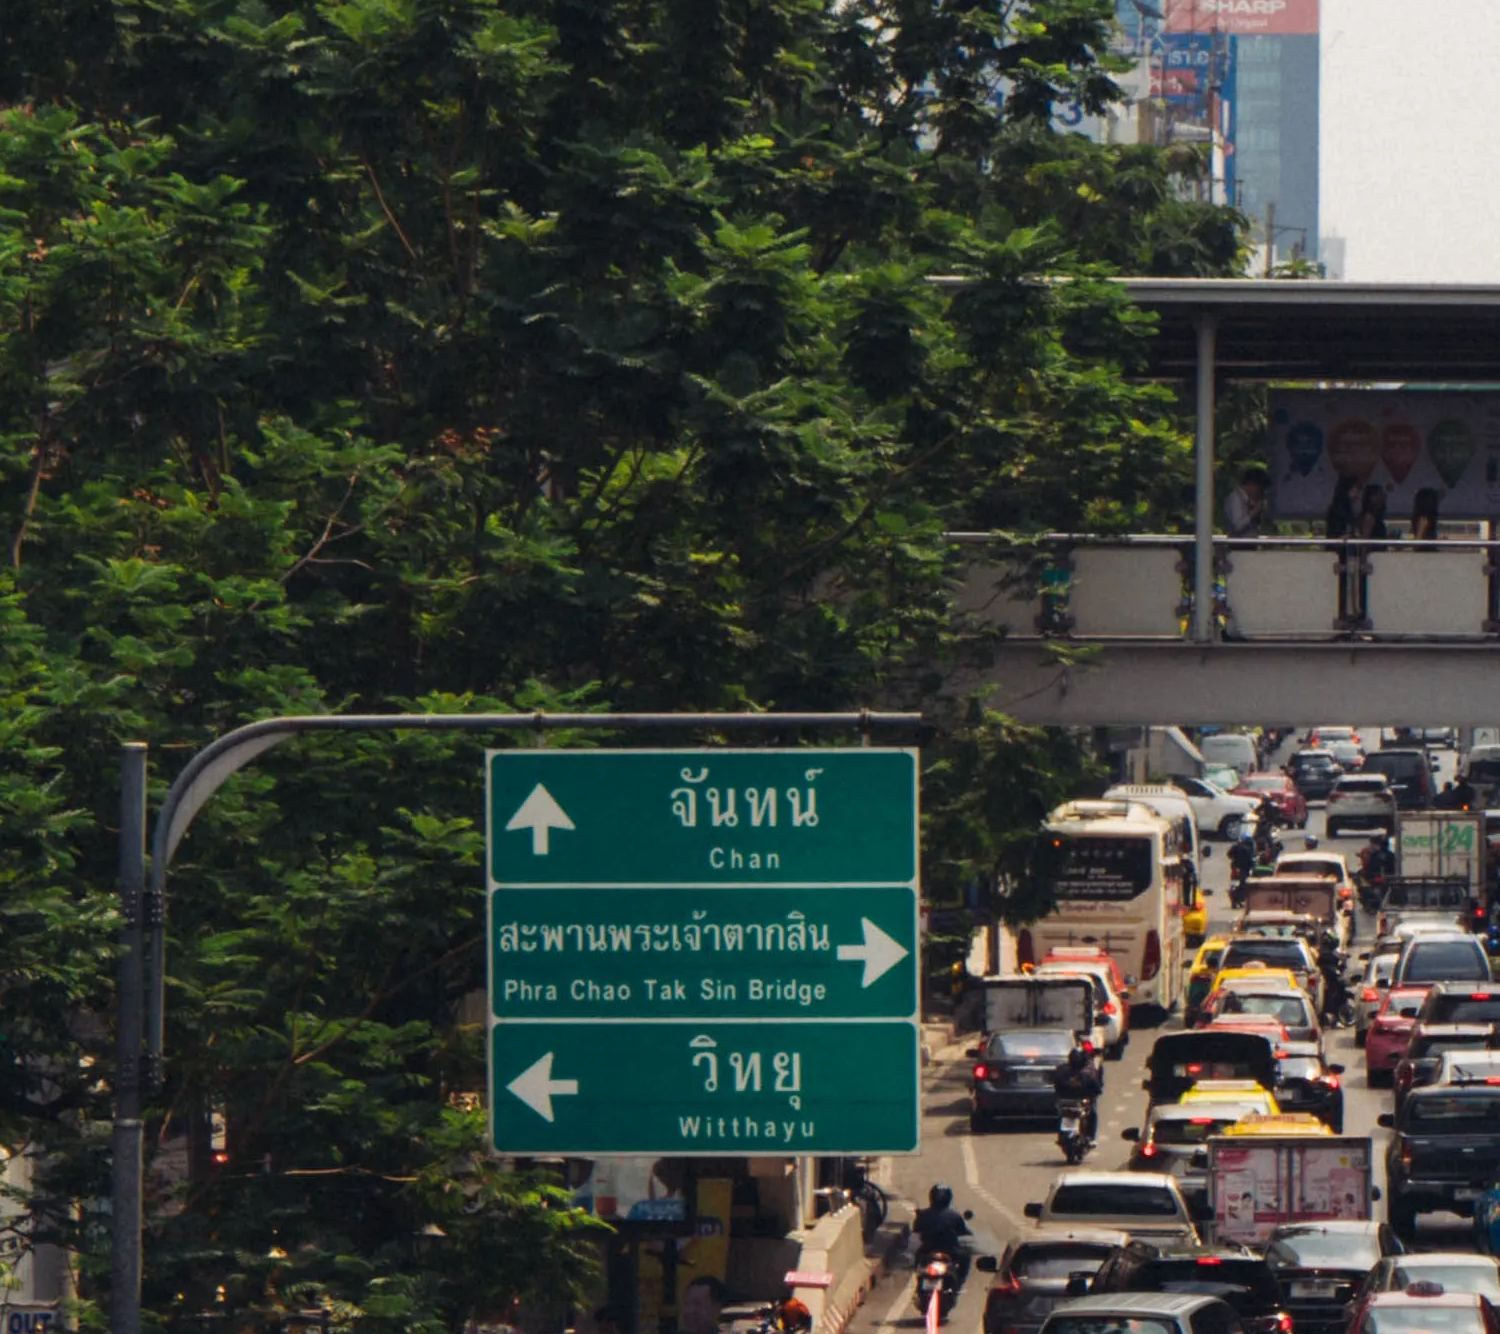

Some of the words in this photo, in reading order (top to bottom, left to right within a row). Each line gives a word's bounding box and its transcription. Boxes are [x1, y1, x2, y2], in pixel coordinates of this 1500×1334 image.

[670, 767, 823, 827] จันทน์
[709, 848, 781, 869] Chan
[500, 910, 831, 952] สะพานพระเจ้าตากสิน
[504, 979, 557, 1001] Phra
[571, 979, 631, 1001] Chao
[645, 979, 687, 1001] Tak
[700, 979, 736, 1001] Sin
[749, 979, 827, 1005] Bridge
[689, 1035, 802, 1110] วิทยุ
[679, 1116, 816, 1142] Witthayu
[10, 1312, 52, 1334] OUT
